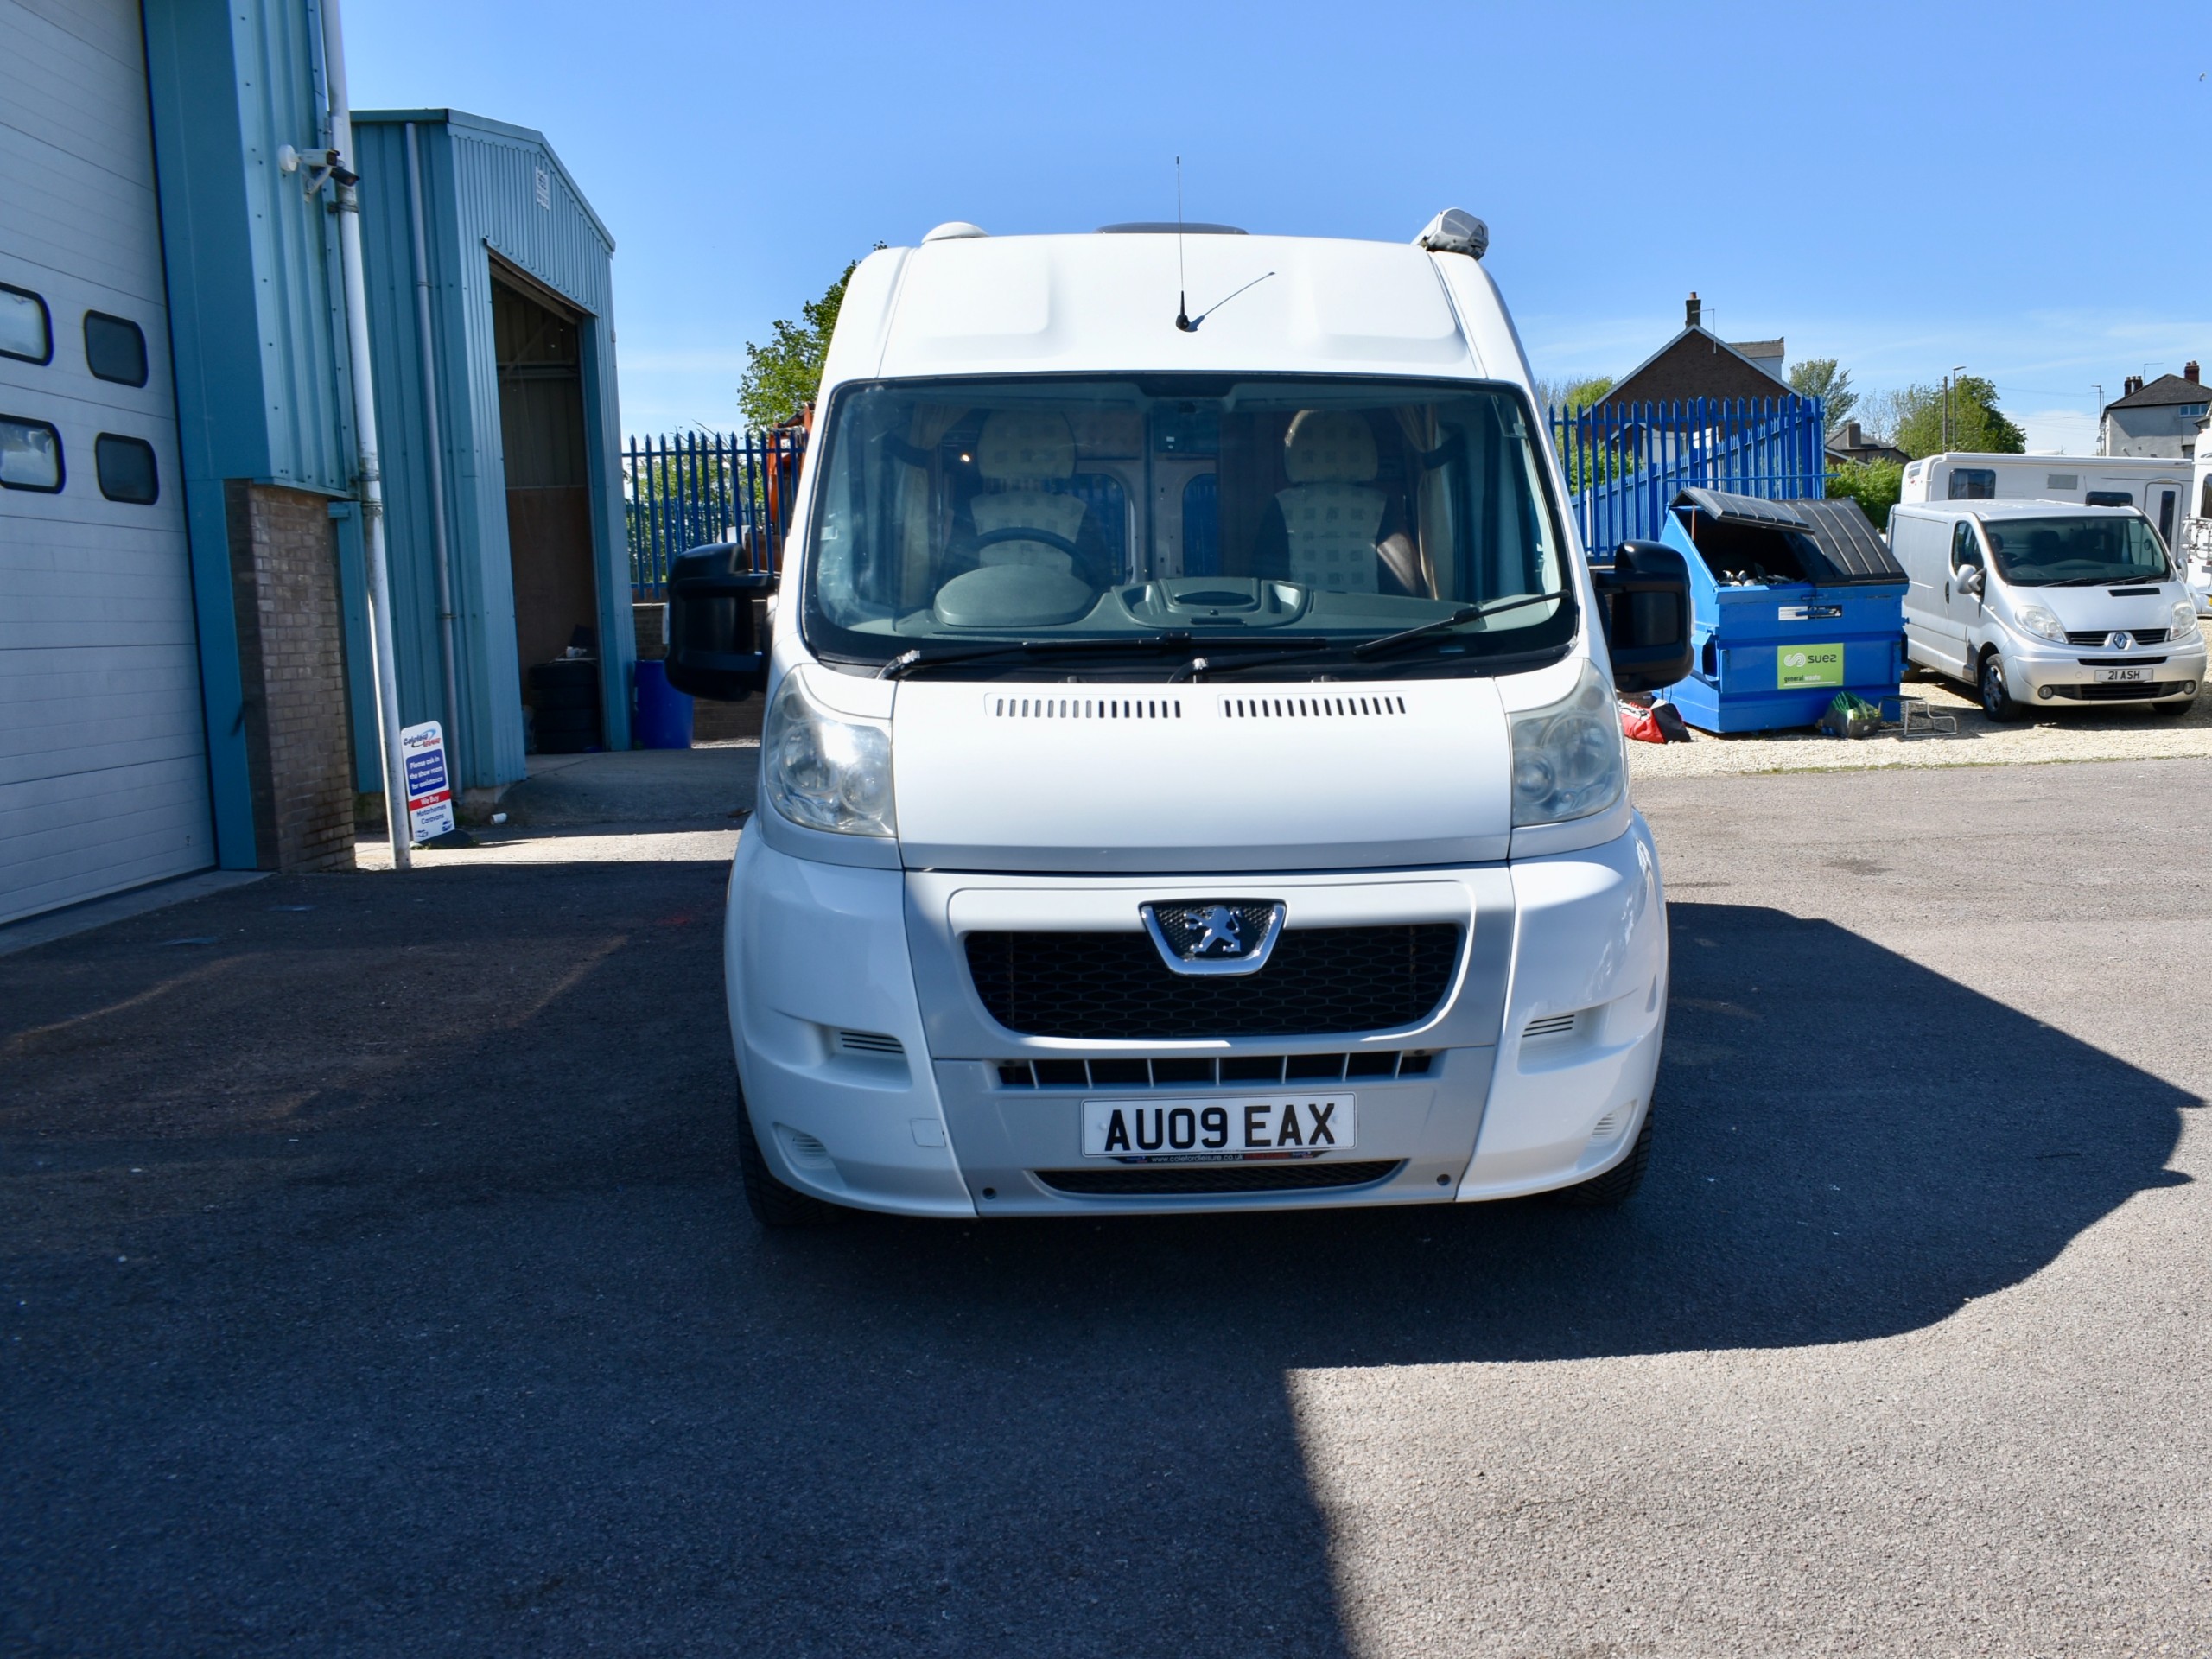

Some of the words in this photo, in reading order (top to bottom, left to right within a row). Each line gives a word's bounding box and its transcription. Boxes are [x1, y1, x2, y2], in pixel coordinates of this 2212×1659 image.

[1807, 654, 1837, 664] suez
[1783, 675, 1803, 683] general
[2108, 671, 2118, 680] 21
[2120, 671, 2140, 680] ASH
[410, 760, 426, 769] Please
[430, 766, 443, 774] room
[419, 776, 443, 785] assistance
[416, 804, 447, 817] Motorhomes
[422, 813, 444, 824] Caravans
[1104, 1107, 1228, 1152] AU09
[1244, 1103, 1335, 1147] EAX
[1151, 1154, 1244, 1163] www.colefordleisure.co.uk
